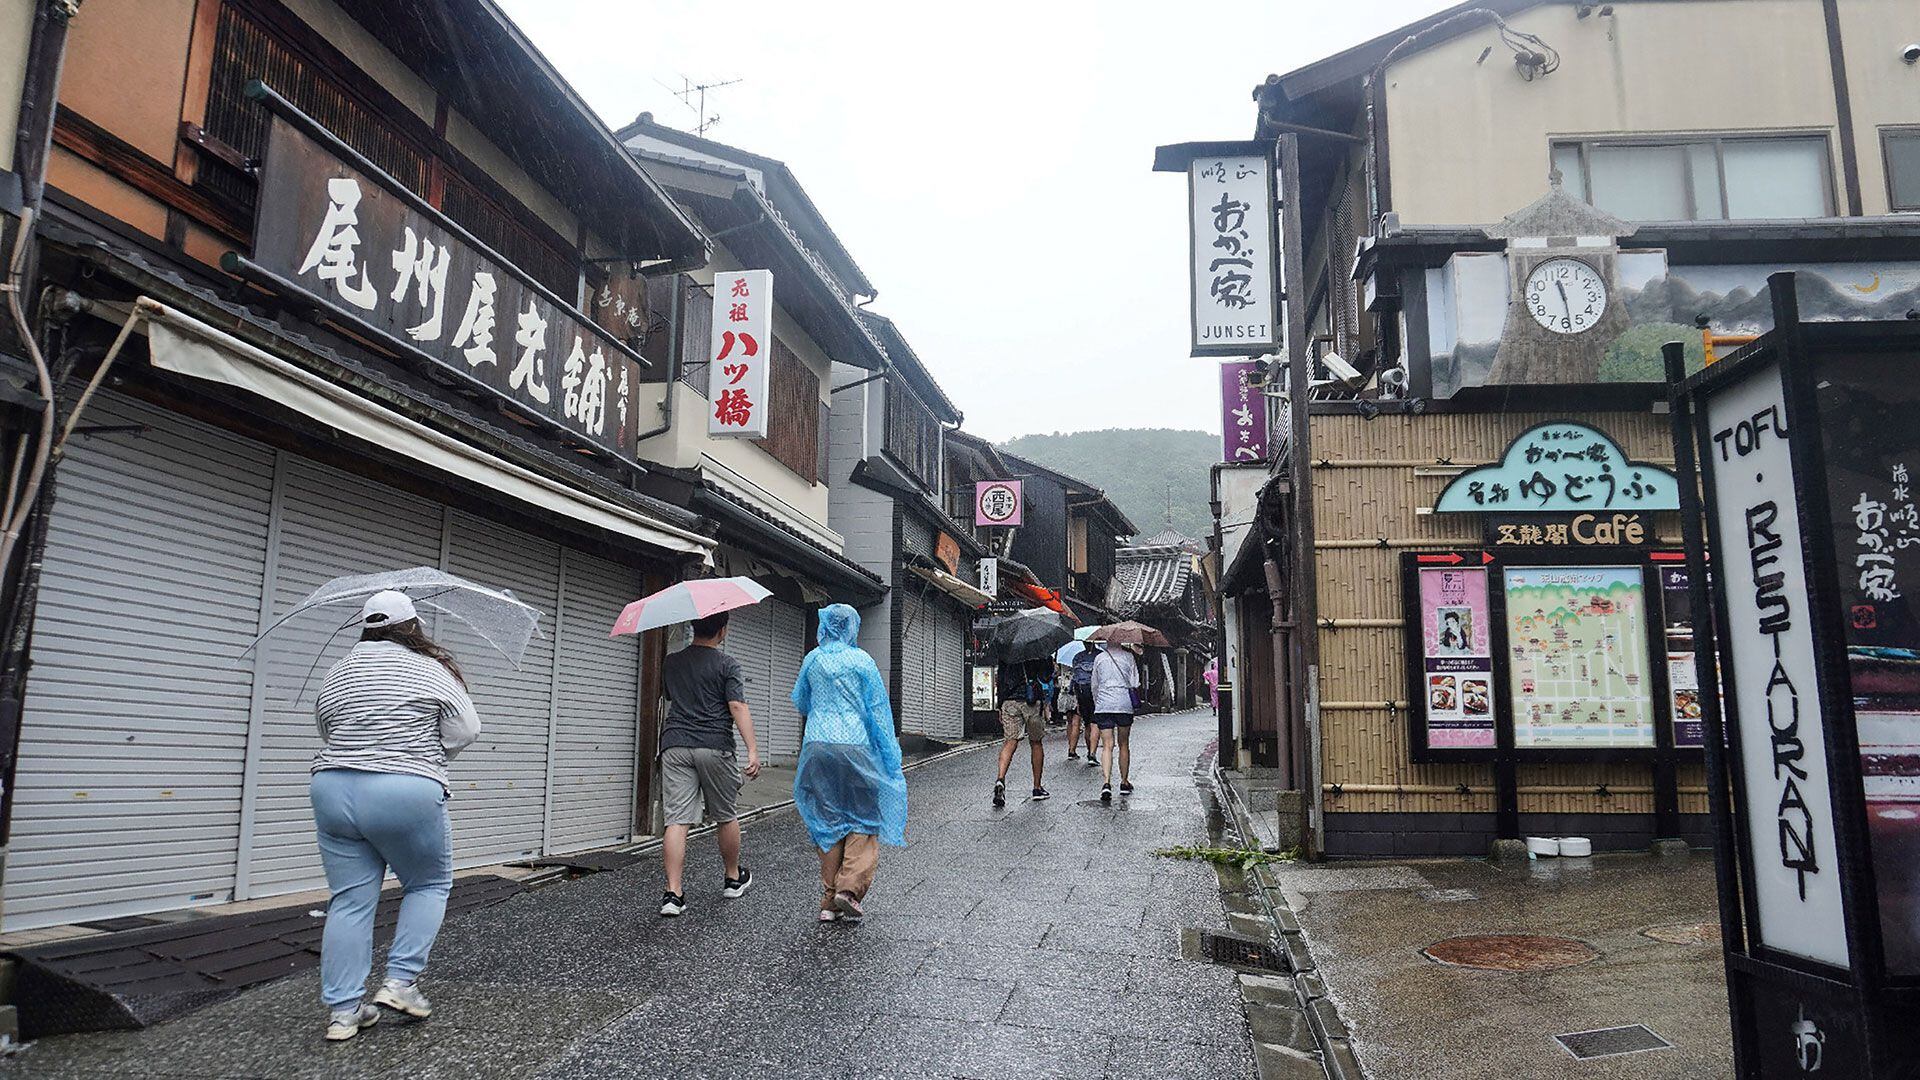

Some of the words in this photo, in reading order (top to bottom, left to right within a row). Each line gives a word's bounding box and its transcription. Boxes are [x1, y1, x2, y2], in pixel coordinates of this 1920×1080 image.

[1208, 192, 1257, 310] おかべ家
[1544, 270, 1554, 282] 11
[1556, 267, 1569, 279] 12
[1575, 269, 1579, 281] 1
[1533, 280, 1546, 292] 10
[1583, 278, 1592, 290] 2
[728, 277, 750, 322] 元祖
[1530, 293, 1540, 305] 9
[1587, 291, 1597, 303] 3
[298, 178, 613, 436] 尾州屋老舗
[1536, 304, 1546, 317] 8
[1584, 304, 1594, 316] 4
[1548, 314, 1557, 326] 7
[1561, 317, 1571, 329] 6
[1575, 314, 1584, 325] 5
[1202, 324, 1267, 339] JUNSEI
[1713, 404, 1789, 462] TOFU
[1467, 480, 1511, 505] 名物
[1519, 463, 1657, 508] ゆどうふ
[990, 489, 1006, 517] 西尾
[1496, 523, 1569, 546] 五龍閣
[1571, 513, 1645, 545] Café
[1852, 491, 1902, 603] おかべ家
[1745, 500, 1820, 903] RESTAURANT
